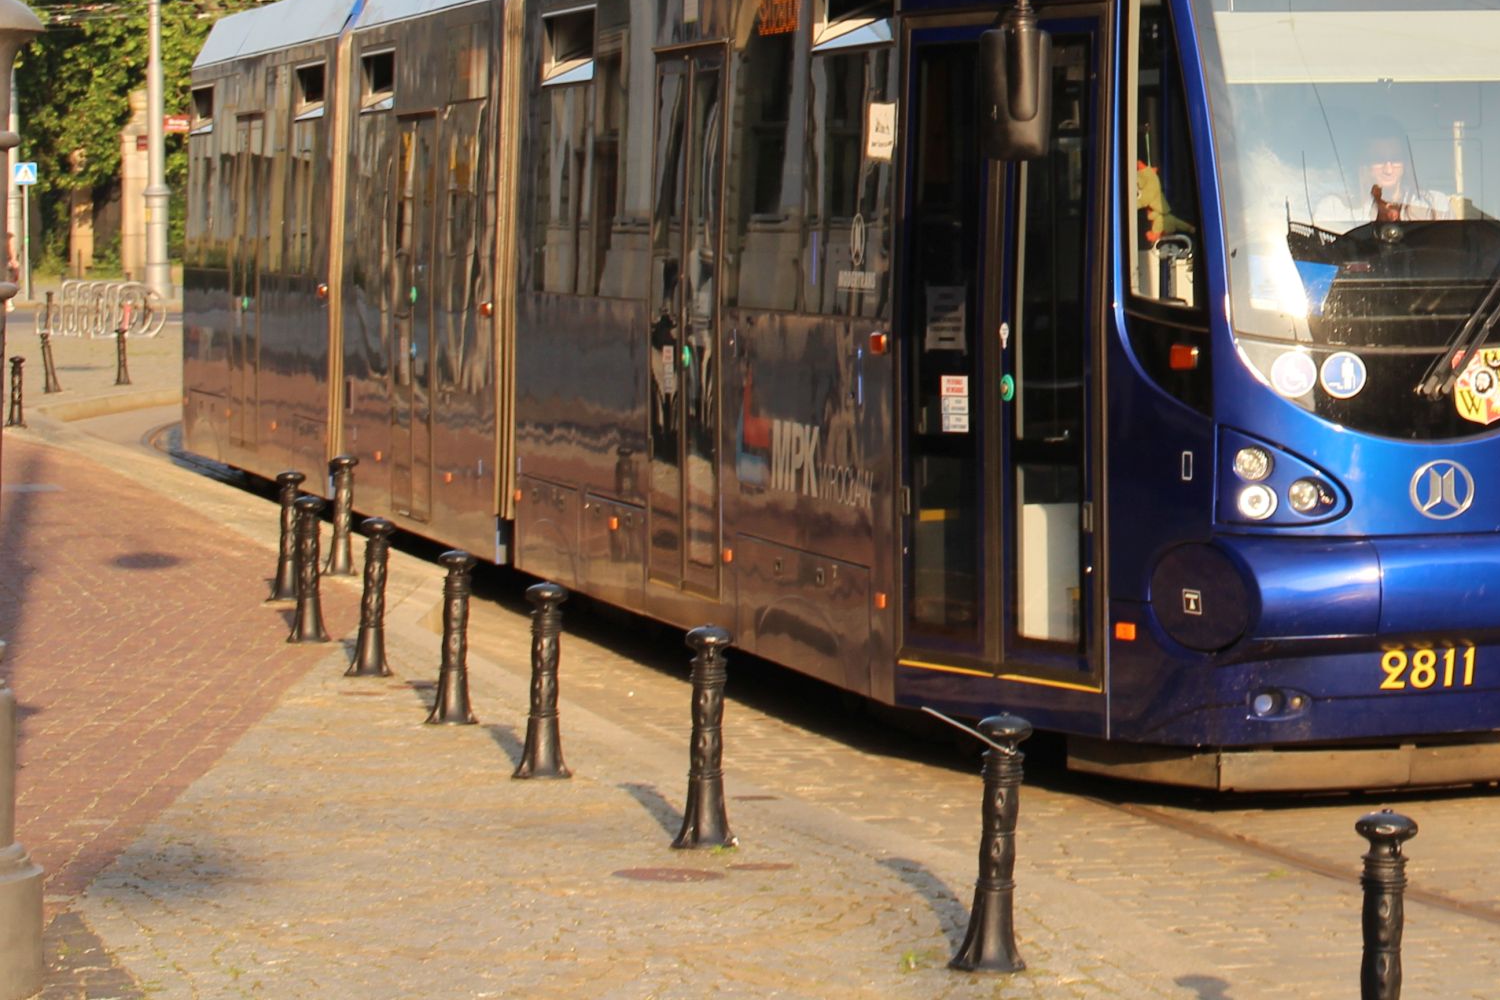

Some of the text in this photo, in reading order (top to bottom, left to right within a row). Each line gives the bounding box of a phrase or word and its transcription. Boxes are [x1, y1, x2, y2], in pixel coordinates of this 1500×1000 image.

[1460, 391, 1483, 416] W
[771, 419, 820, 498] MPK
[1380, 646, 1476, 690] 2811
